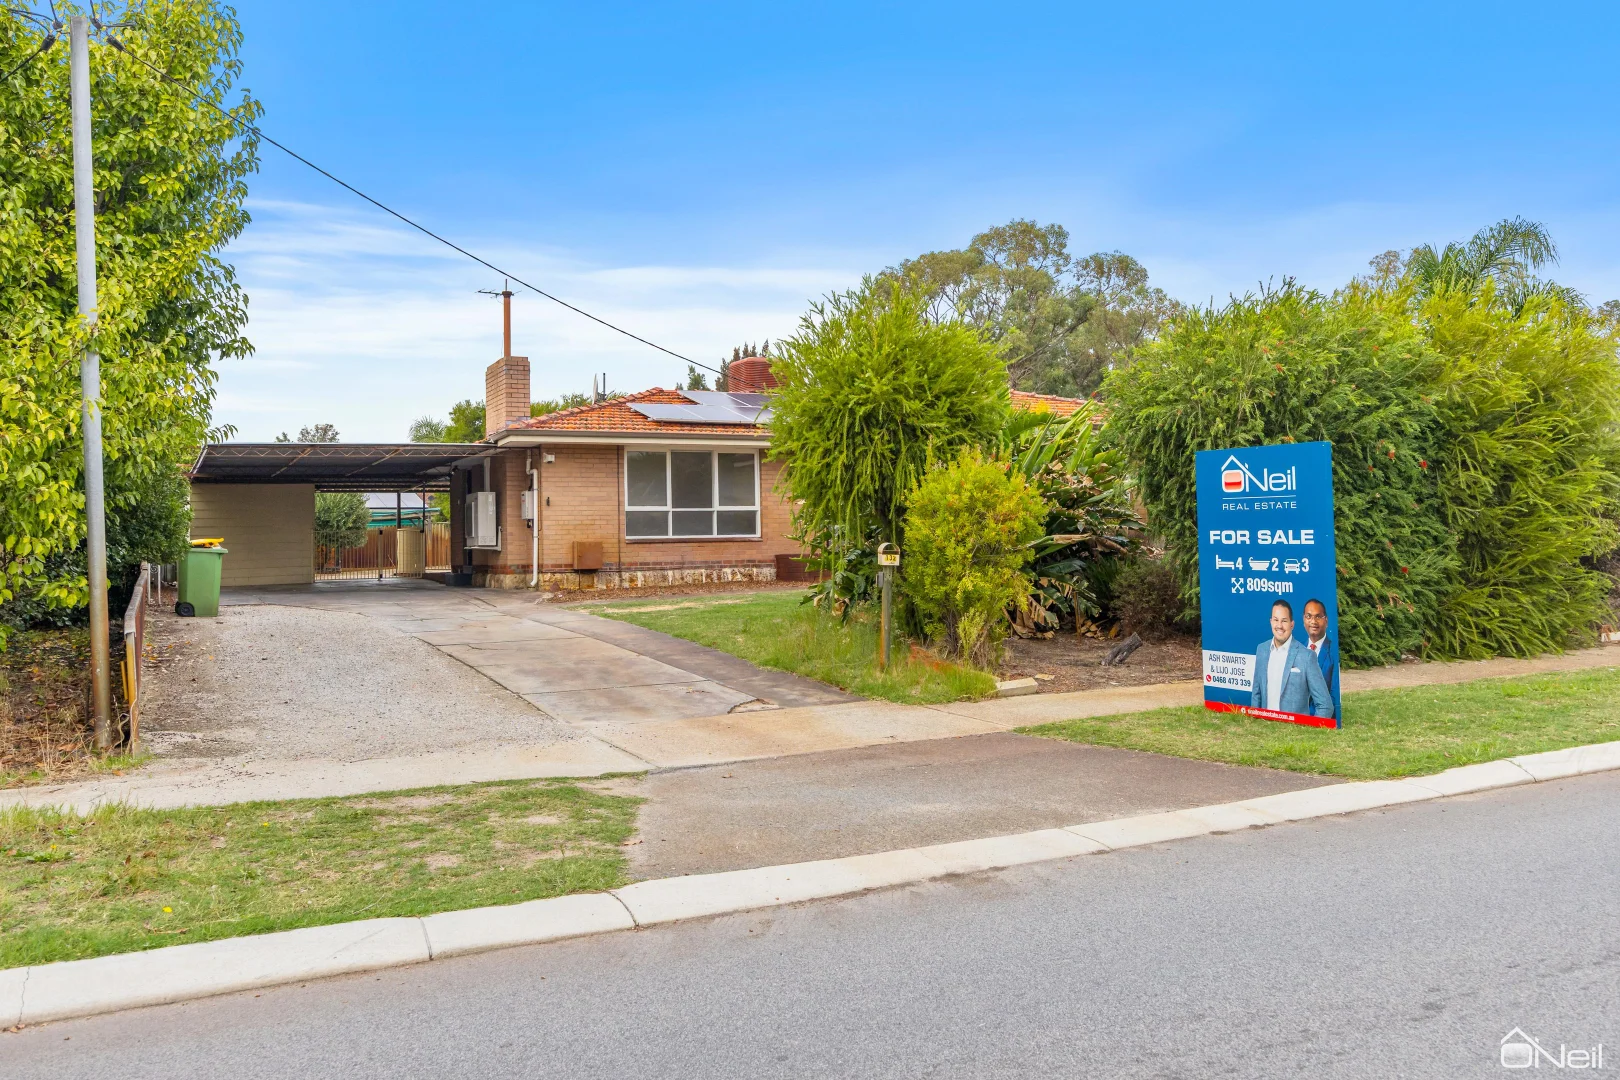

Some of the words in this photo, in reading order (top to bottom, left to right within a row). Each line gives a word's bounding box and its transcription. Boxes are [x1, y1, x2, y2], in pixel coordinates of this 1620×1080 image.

[1222, 502, 1249, 511] REAL
[1254, 501, 1297, 510] ESTATE
[1209, 530, 1250, 545] FOR
[1257, 529, 1315, 545] SALE
[1235, 557, 1243, 570] 4
[1271, 557, 1279, 571] 2
[1301, 557, 1310, 572] 3
[1246, 577, 1293, 595] 809sqm
[1208, 653, 1221, 663] ASH
[1221, 655, 1246, 665] SWARTS
[1210, 665, 1215, 673] &
[1216, 666, 1229, 674] LIJO
[1230, 667, 1245, 677] JOSE
[1212, 675, 1227, 684] 0468
[1228, 676, 1239, 686] 473
[1239, 678, 1252, 687] 339
